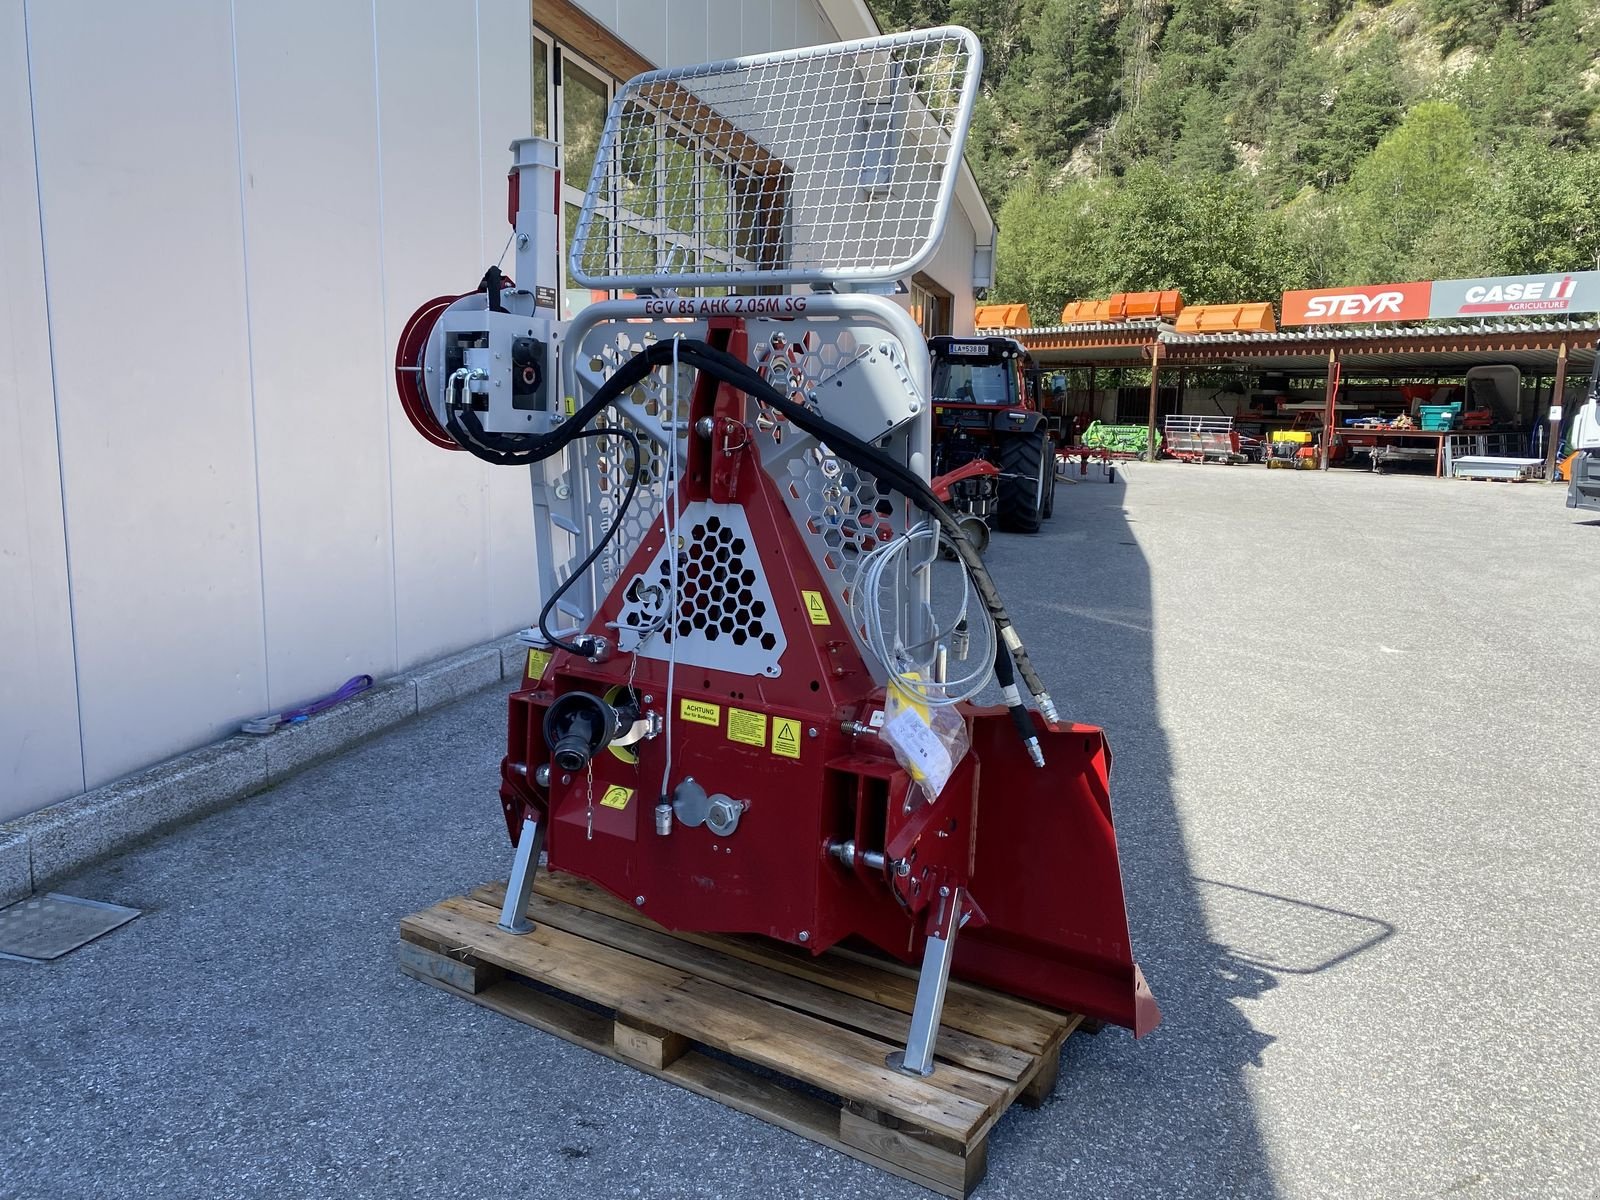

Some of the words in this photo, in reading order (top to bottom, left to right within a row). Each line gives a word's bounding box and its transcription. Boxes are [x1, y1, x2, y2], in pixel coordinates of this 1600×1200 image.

[1465, 282, 1545, 303] CASE
[646, 300, 674, 314] EGV
[678, 300, 695, 314] 85
[700, 299, 730, 313] AHK
[735, 298, 780, 313] 2.05M
[784, 297, 807, 312] SG
[1304, 291, 1404, 317] STEYR
[1508, 300, 1565, 311] AGRICULTURE
[687, 705, 714, 715] ACHTUNG
